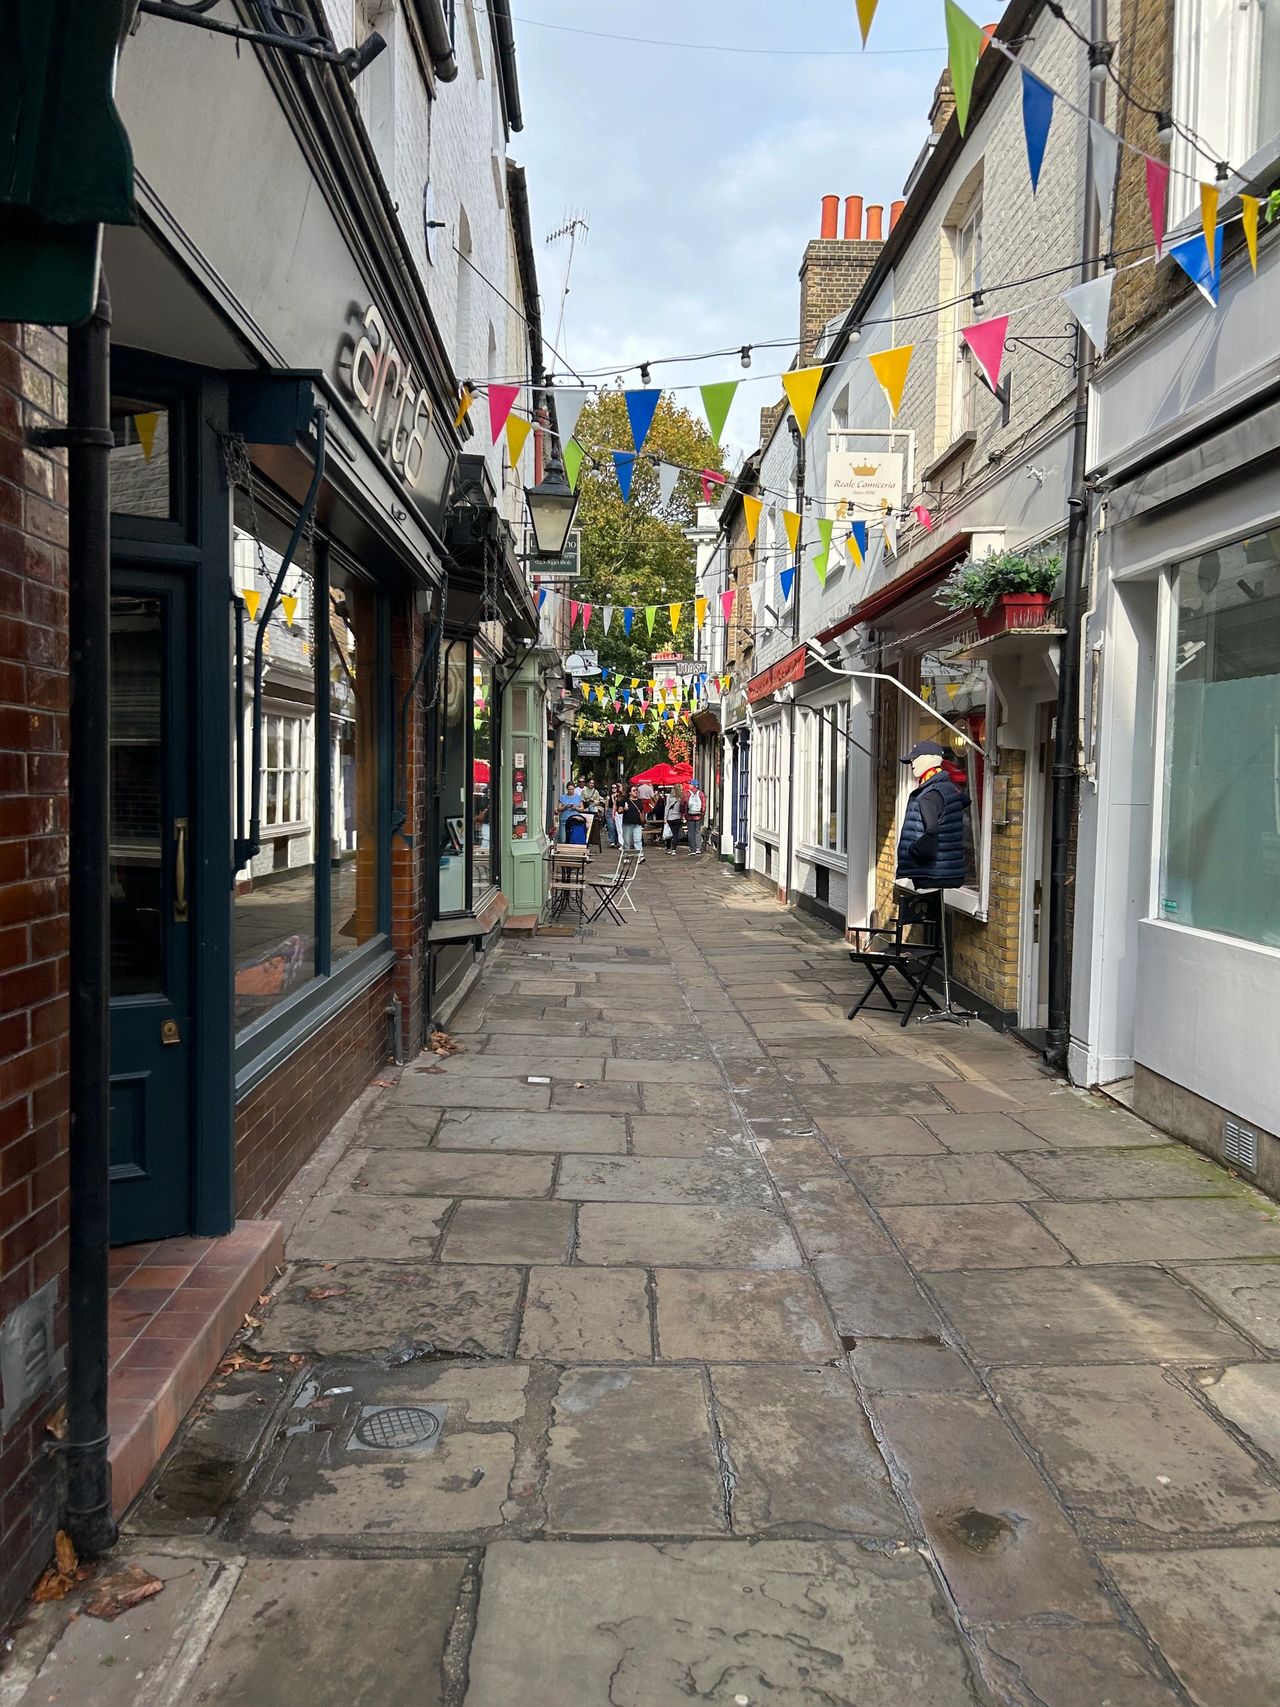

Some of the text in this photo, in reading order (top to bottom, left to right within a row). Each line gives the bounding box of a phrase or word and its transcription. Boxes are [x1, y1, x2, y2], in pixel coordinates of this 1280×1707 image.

[352, 304, 433, 488] anto
[833, 479, 896, 489] Reale Camiceria
